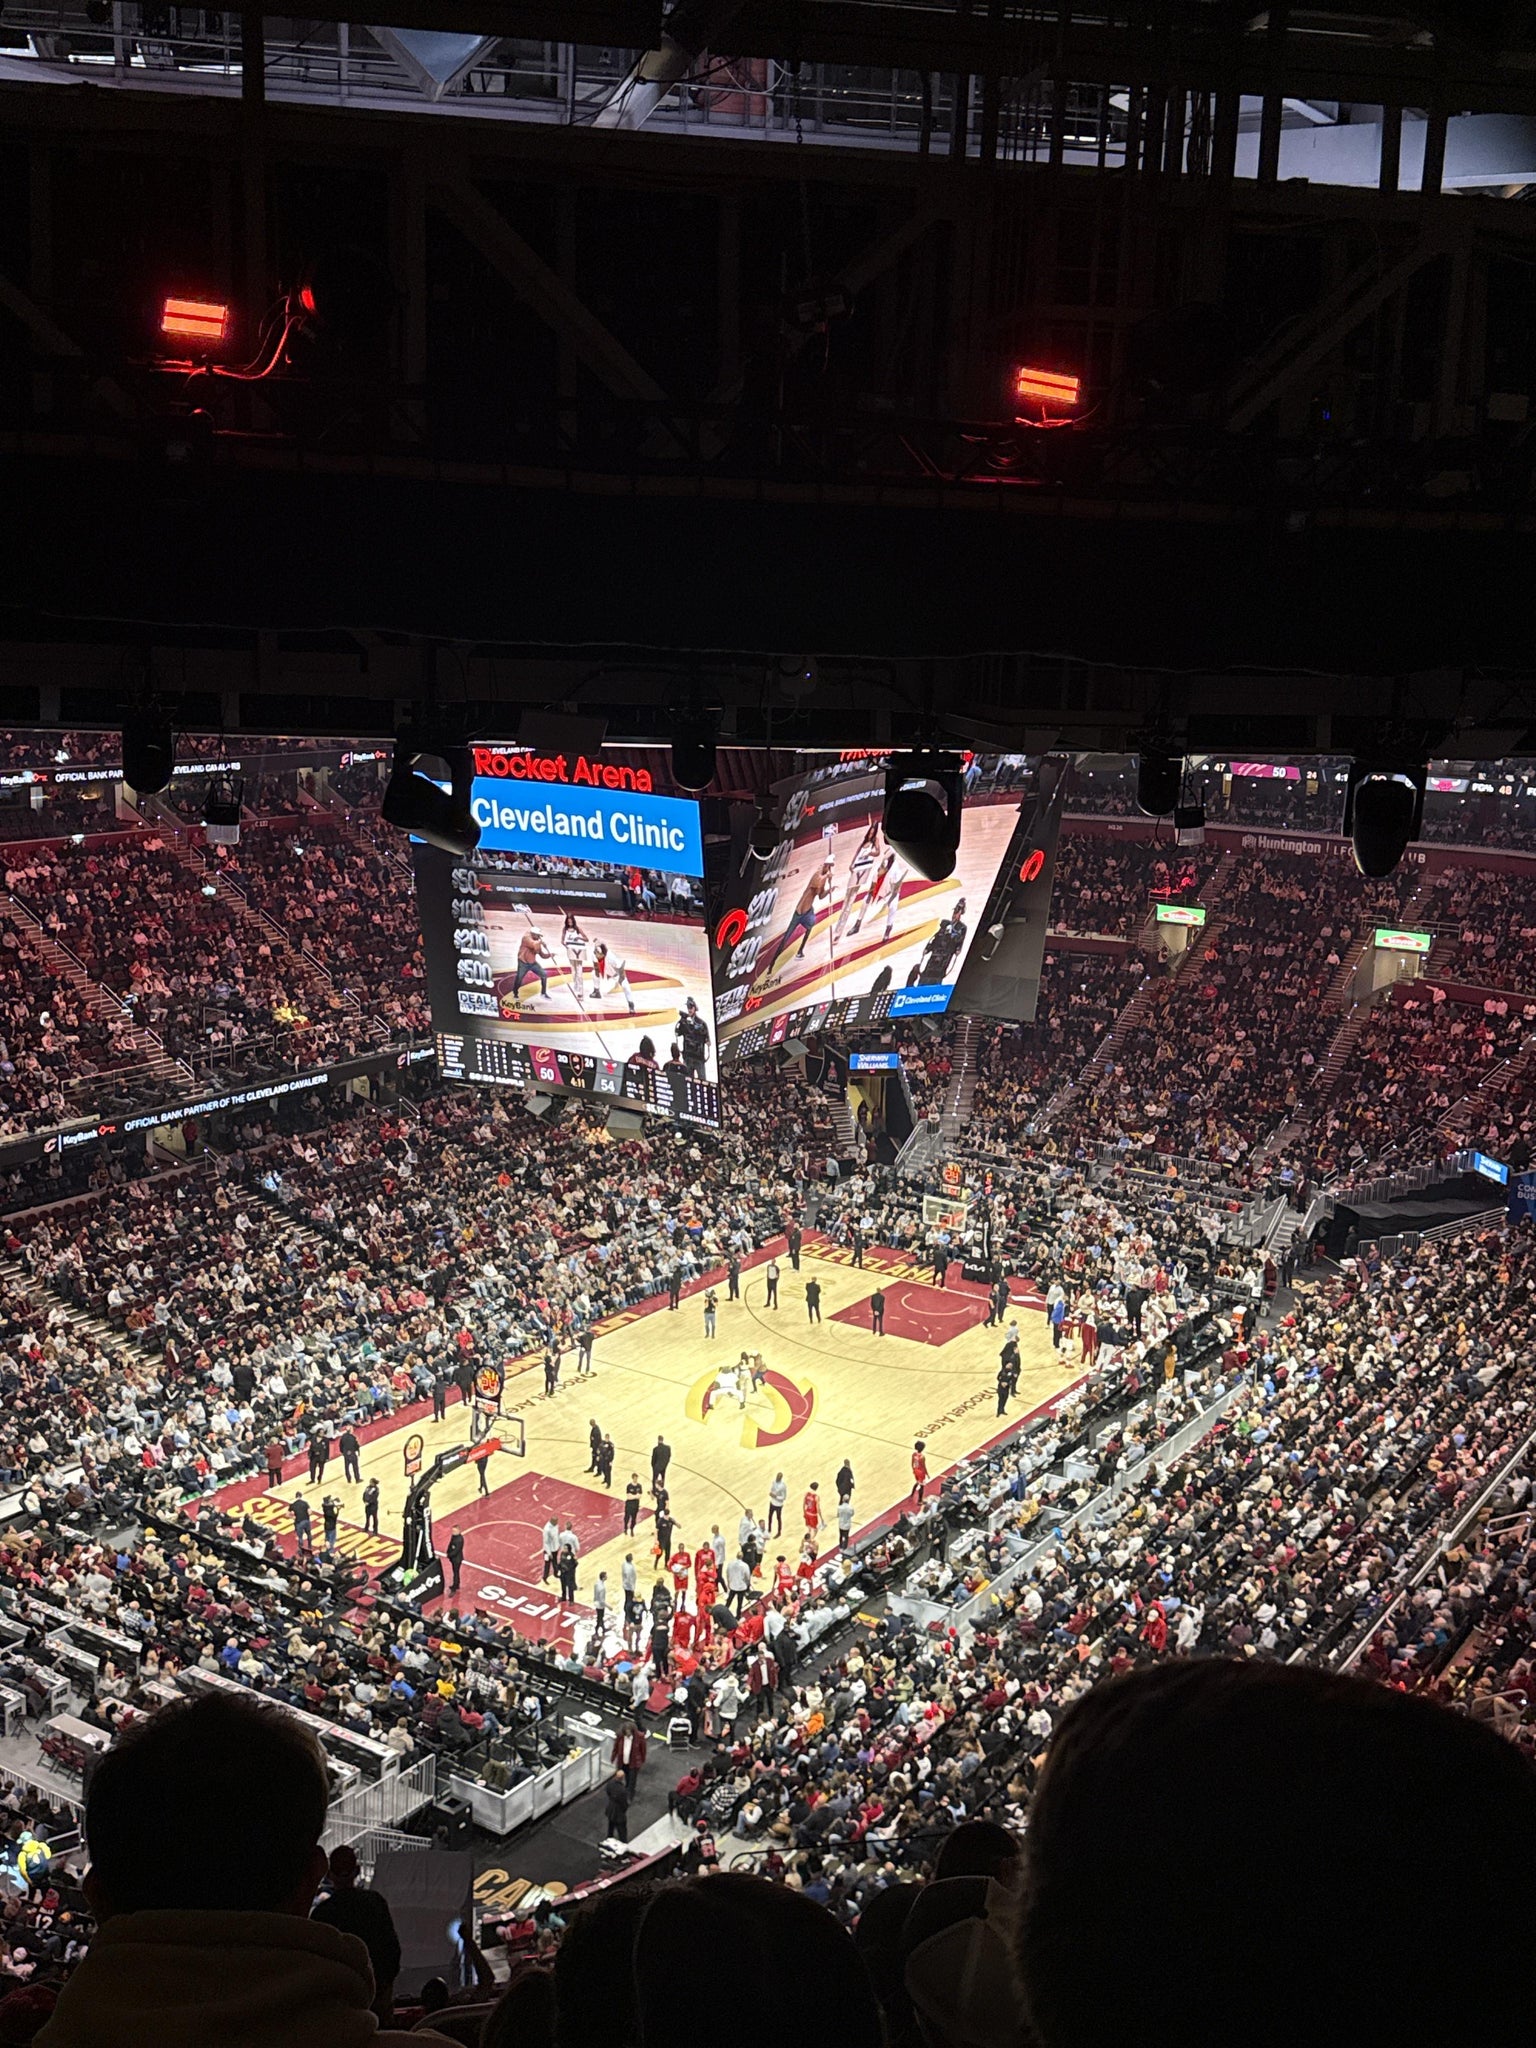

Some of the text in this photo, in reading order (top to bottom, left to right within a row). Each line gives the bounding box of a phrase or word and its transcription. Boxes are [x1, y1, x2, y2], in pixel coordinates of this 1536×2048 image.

[55, 772, 87, 783] OFFICIAL
[88, 770, 108, 780] BANK
[475, 749, 652, 792] Rocket Arena
[1272, 767, 1286, 778] 50
[1335, 773, 1348, 782] 4:1
[471, 798, 685, 851] Cleveland Clinic
[1258, 835, 1322, 854] Huntington
[451, 868, 480, 896] $50
[452, 898, 486, 925] $100
[453, 928, 491, 957] $200
[457, 959, 494, 989] $500
[584, 1057, 594, 1068] 24
[540, 1068, 616, 1092] 50 4:11 54
[124, 1074, 328, 1132] OFFICIAL BANK PARTNER OF THE CLEVELAND CAVALIERS
[63, 1129, 98, 1145] KeyBank
[913, 1389, 994, 1439] Rocket Arena
